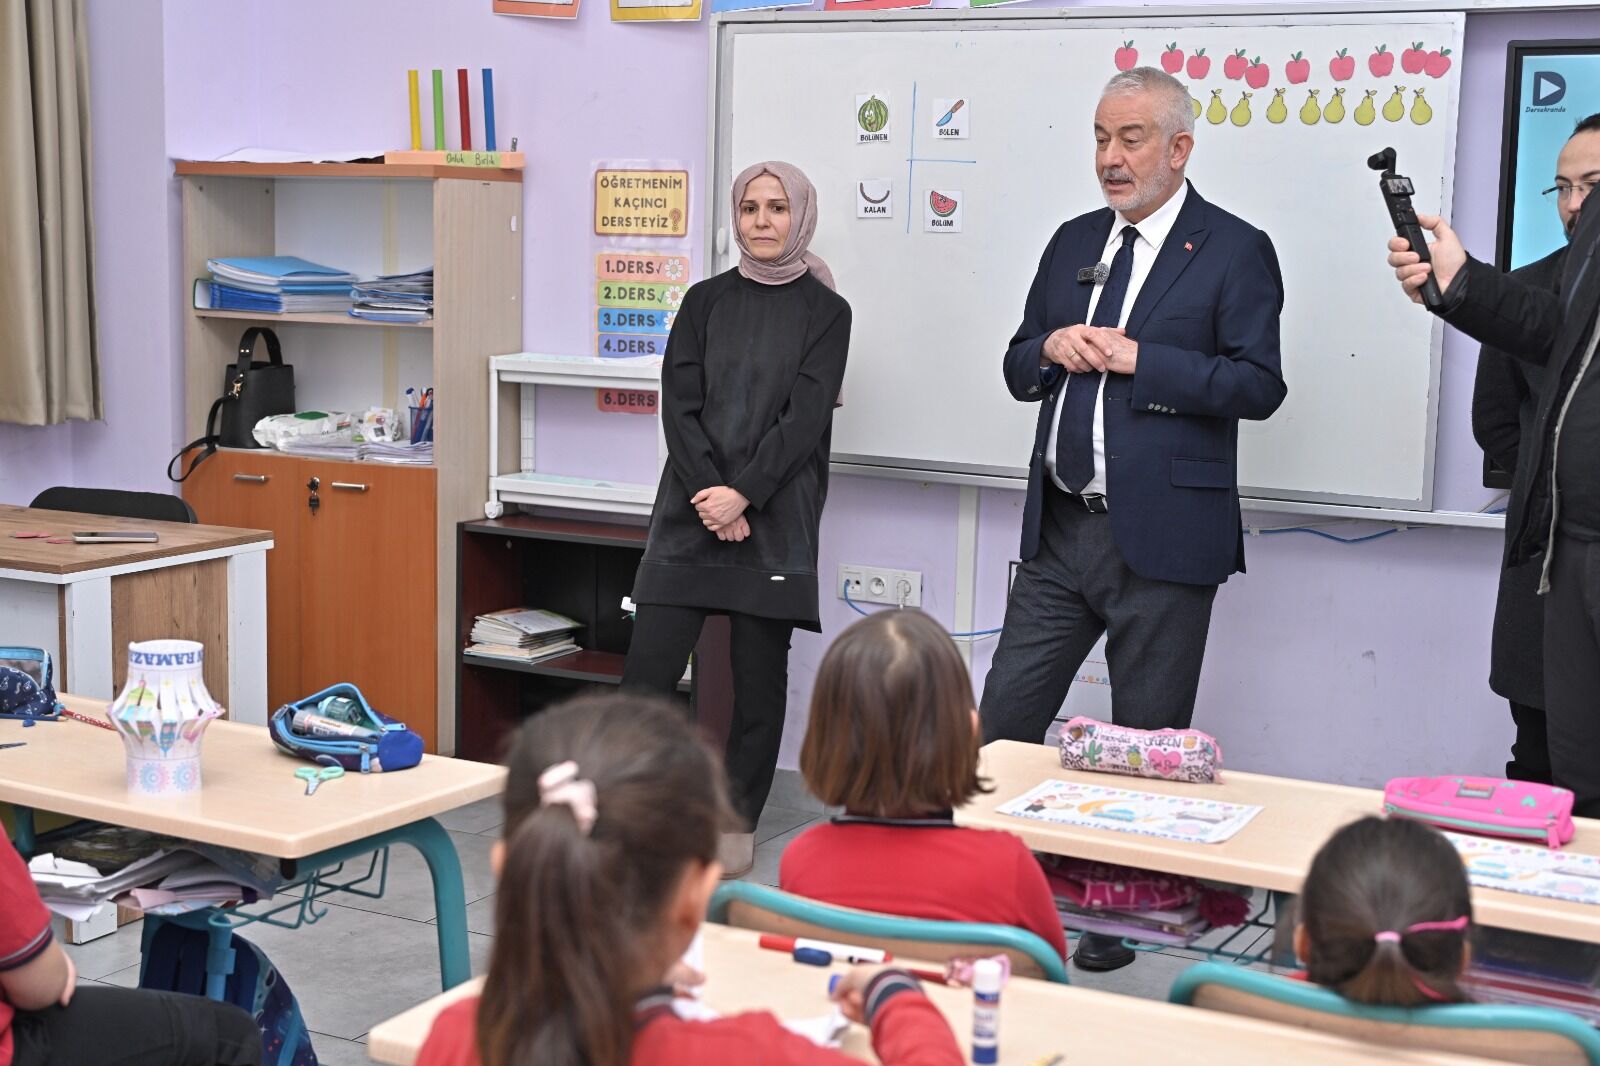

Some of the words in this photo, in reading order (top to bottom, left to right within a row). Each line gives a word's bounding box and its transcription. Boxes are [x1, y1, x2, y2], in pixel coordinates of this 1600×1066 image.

[938, 128, 960, 136] BÖLEN
[600, 174, 683, 190] ÖĞRETMENİM
[613, 197, 667, 211] KAÇINCI
[863, 206, 887, 214] KALAN
[931, 219, 954, 227] BÖLÜM
[605, 259, 655, 274] 1.DERS
[603, 286, 656, 301] 2.DERS
[603, 312, 656, 327] 3.DERS
[603, 339, 656, 354] 4.DERS
[603, 392, 656, 407] 6.DERS
